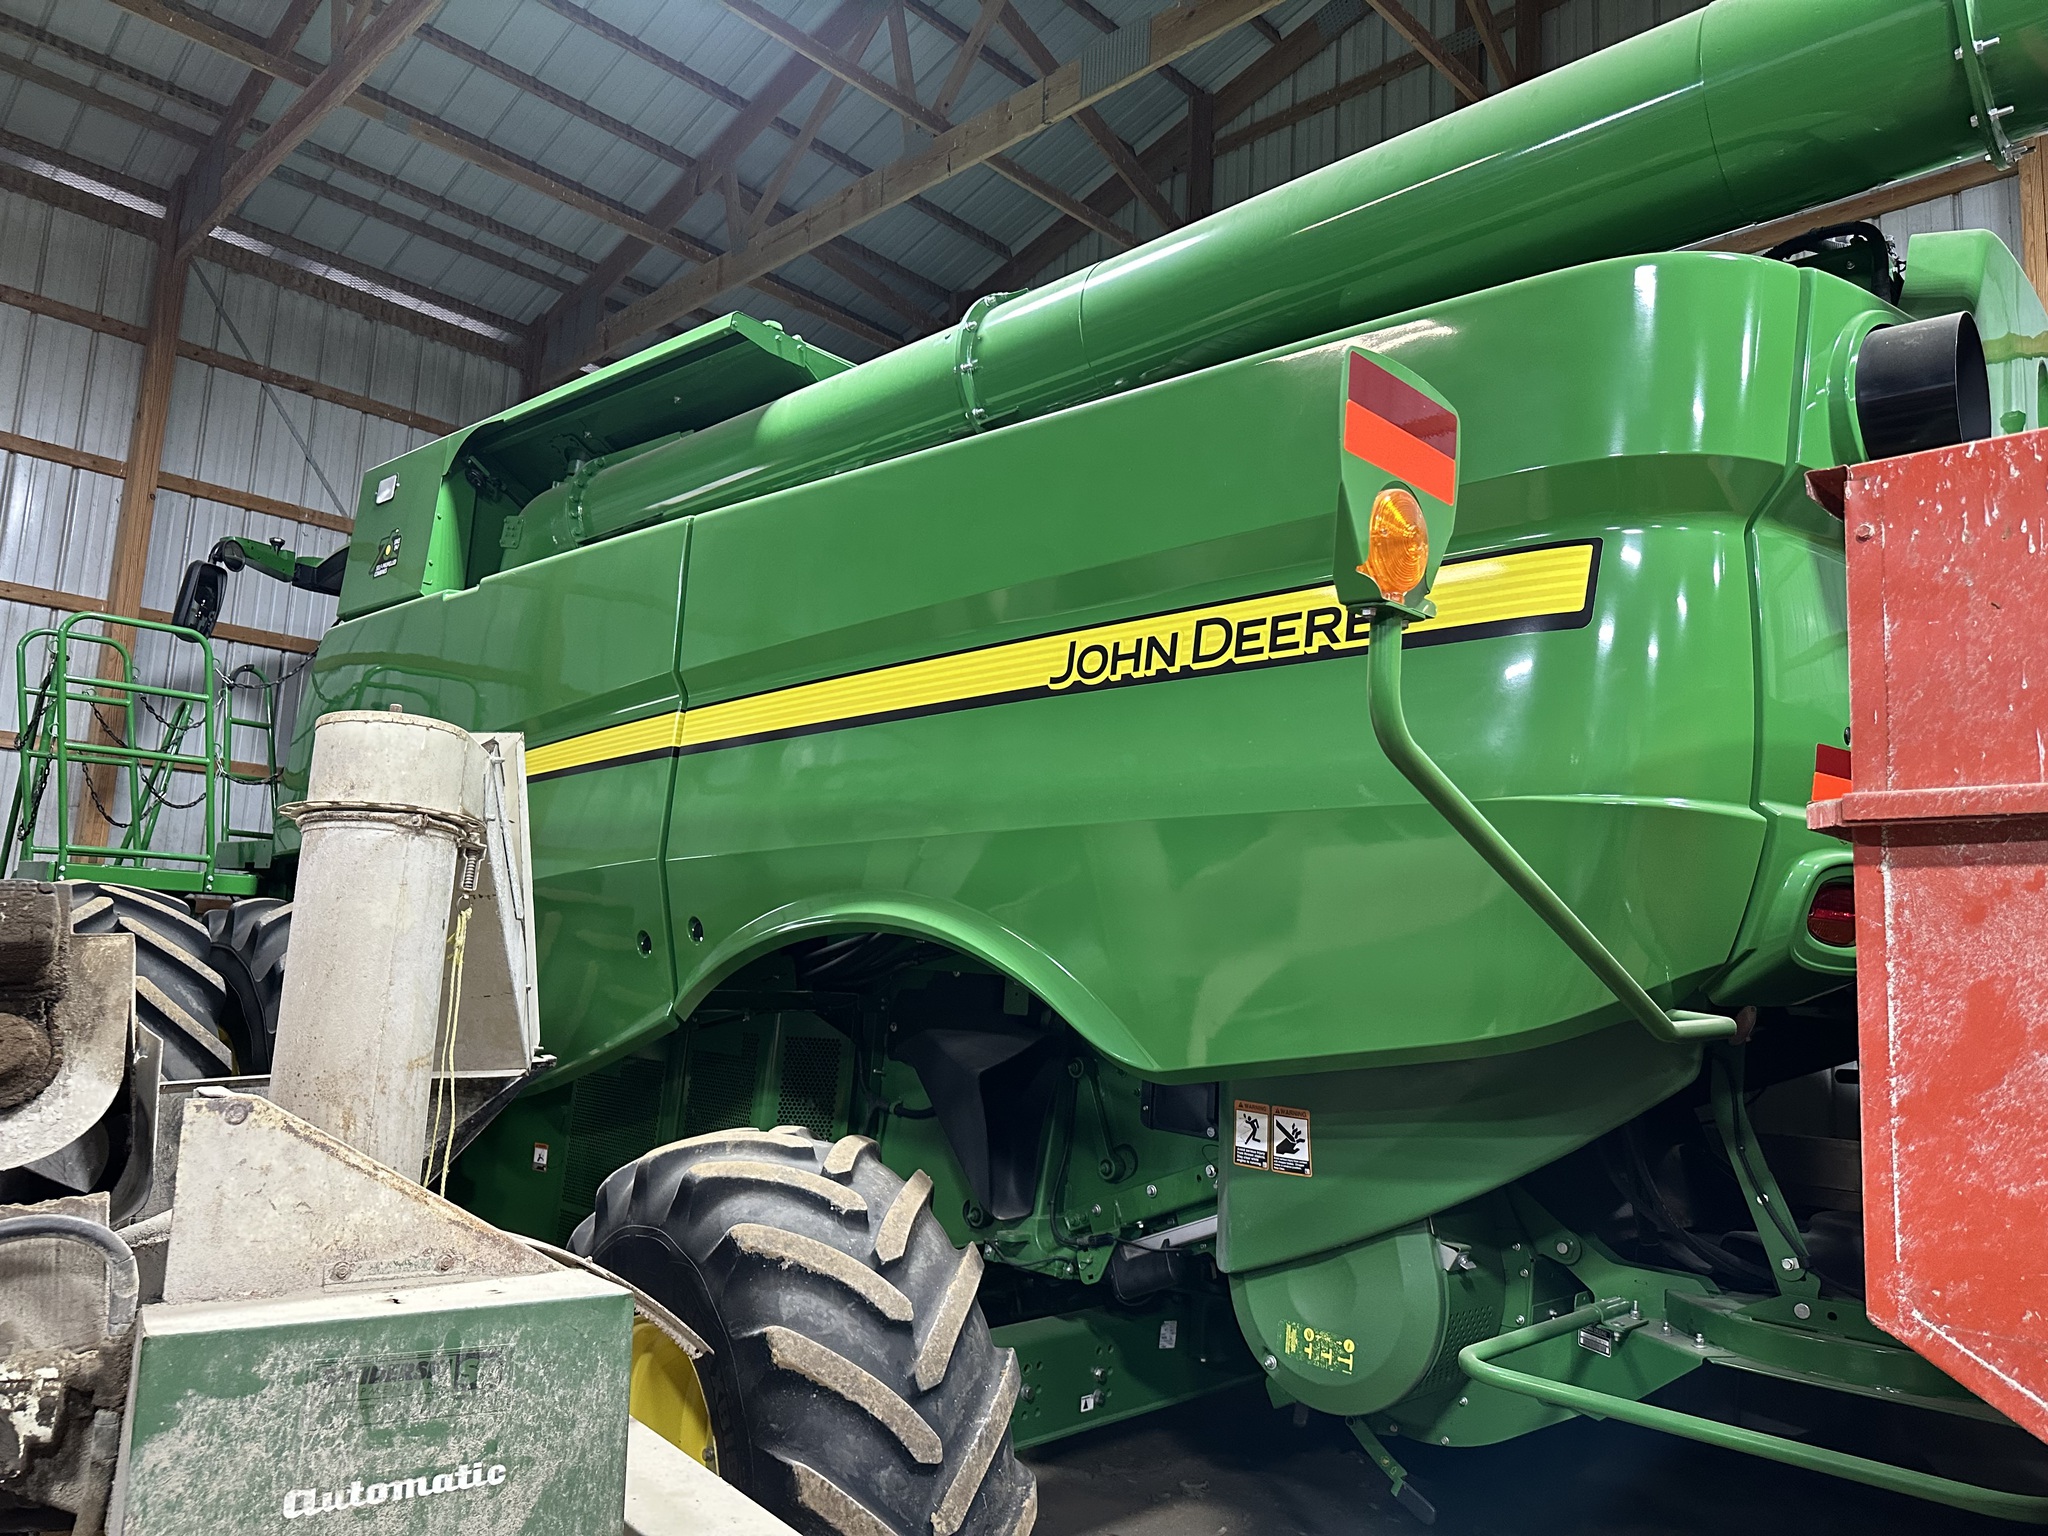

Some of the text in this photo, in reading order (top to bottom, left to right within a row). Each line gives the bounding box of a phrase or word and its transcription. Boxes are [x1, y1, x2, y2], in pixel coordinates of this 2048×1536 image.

[1049, 607, 1371, 685] JOHN DEERE
[1244, 1103, 1267, 1112] WARNING
[1280, 1109, 1307, 1118] WARNING
